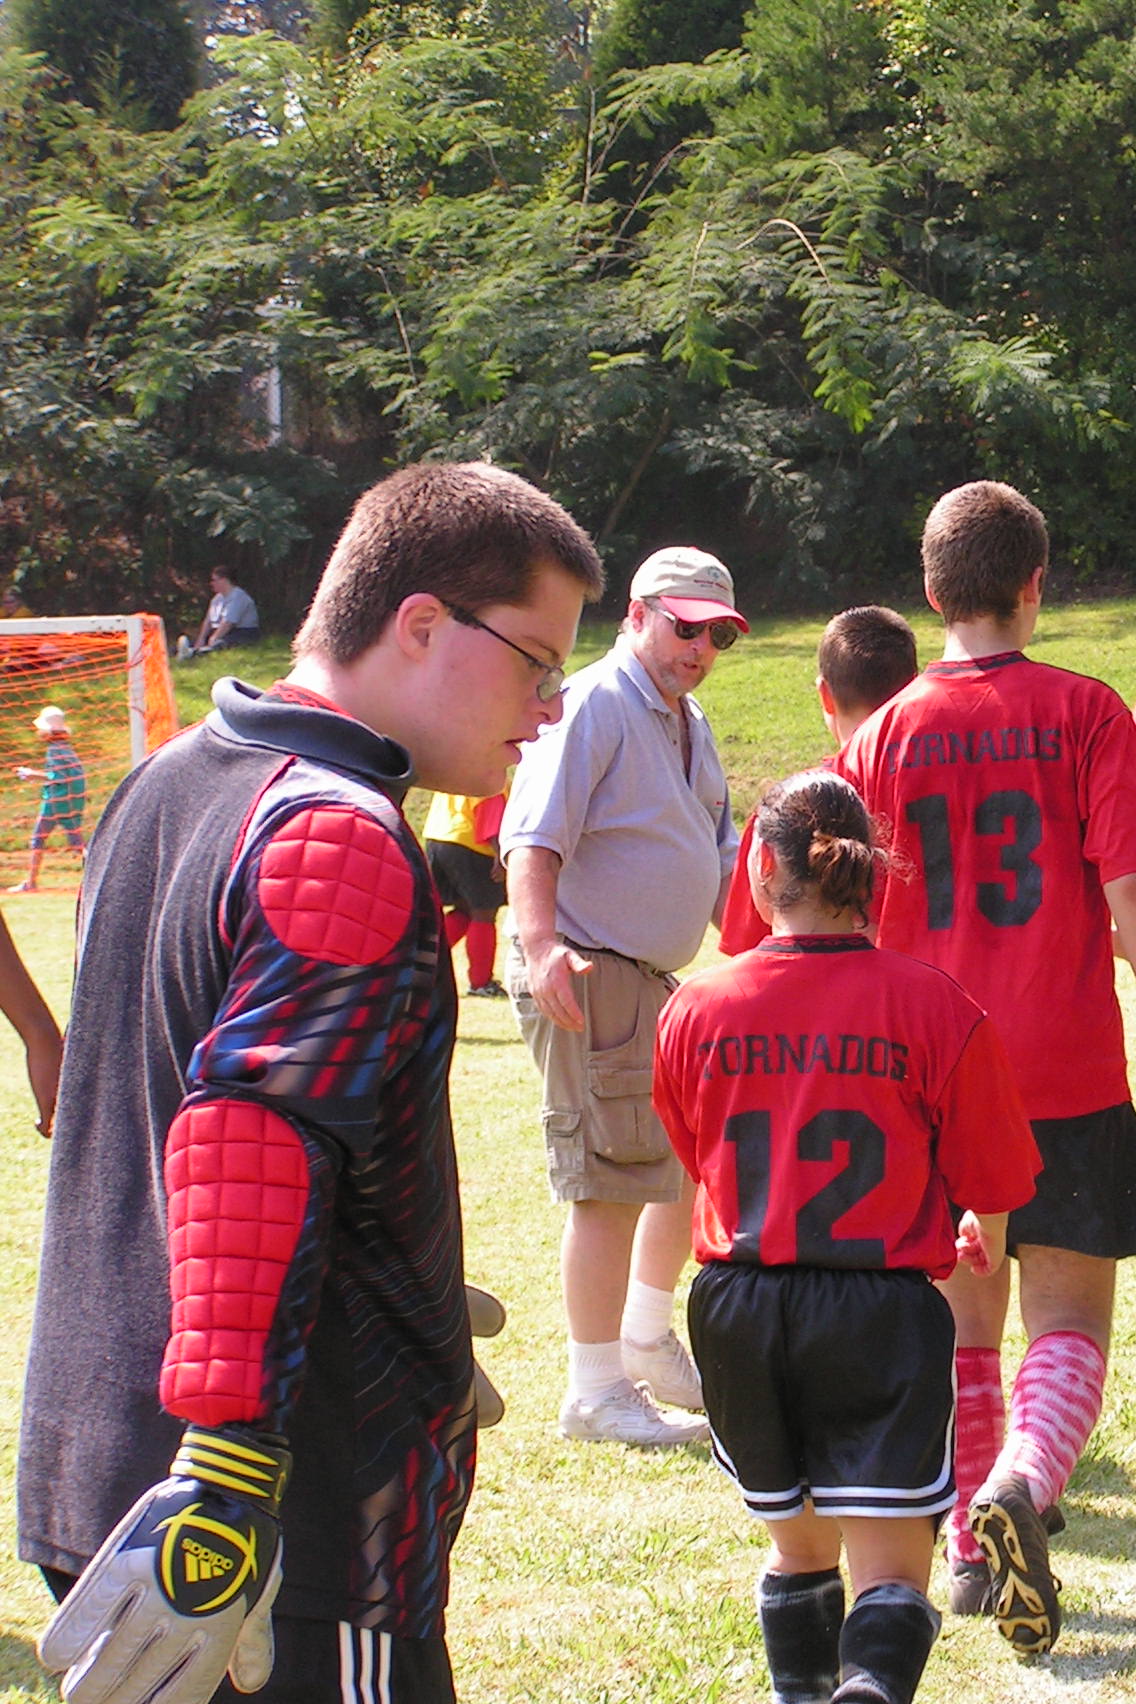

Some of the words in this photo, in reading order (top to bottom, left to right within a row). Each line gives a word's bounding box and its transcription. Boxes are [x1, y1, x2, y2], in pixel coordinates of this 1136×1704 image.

[886, 727, 1063, 774] TORNADOS
[905, 789, 1044, 931] 13
[697, 1034, 909, 1082] TORNADOS
[723, 1108, 887, 1268] 12
